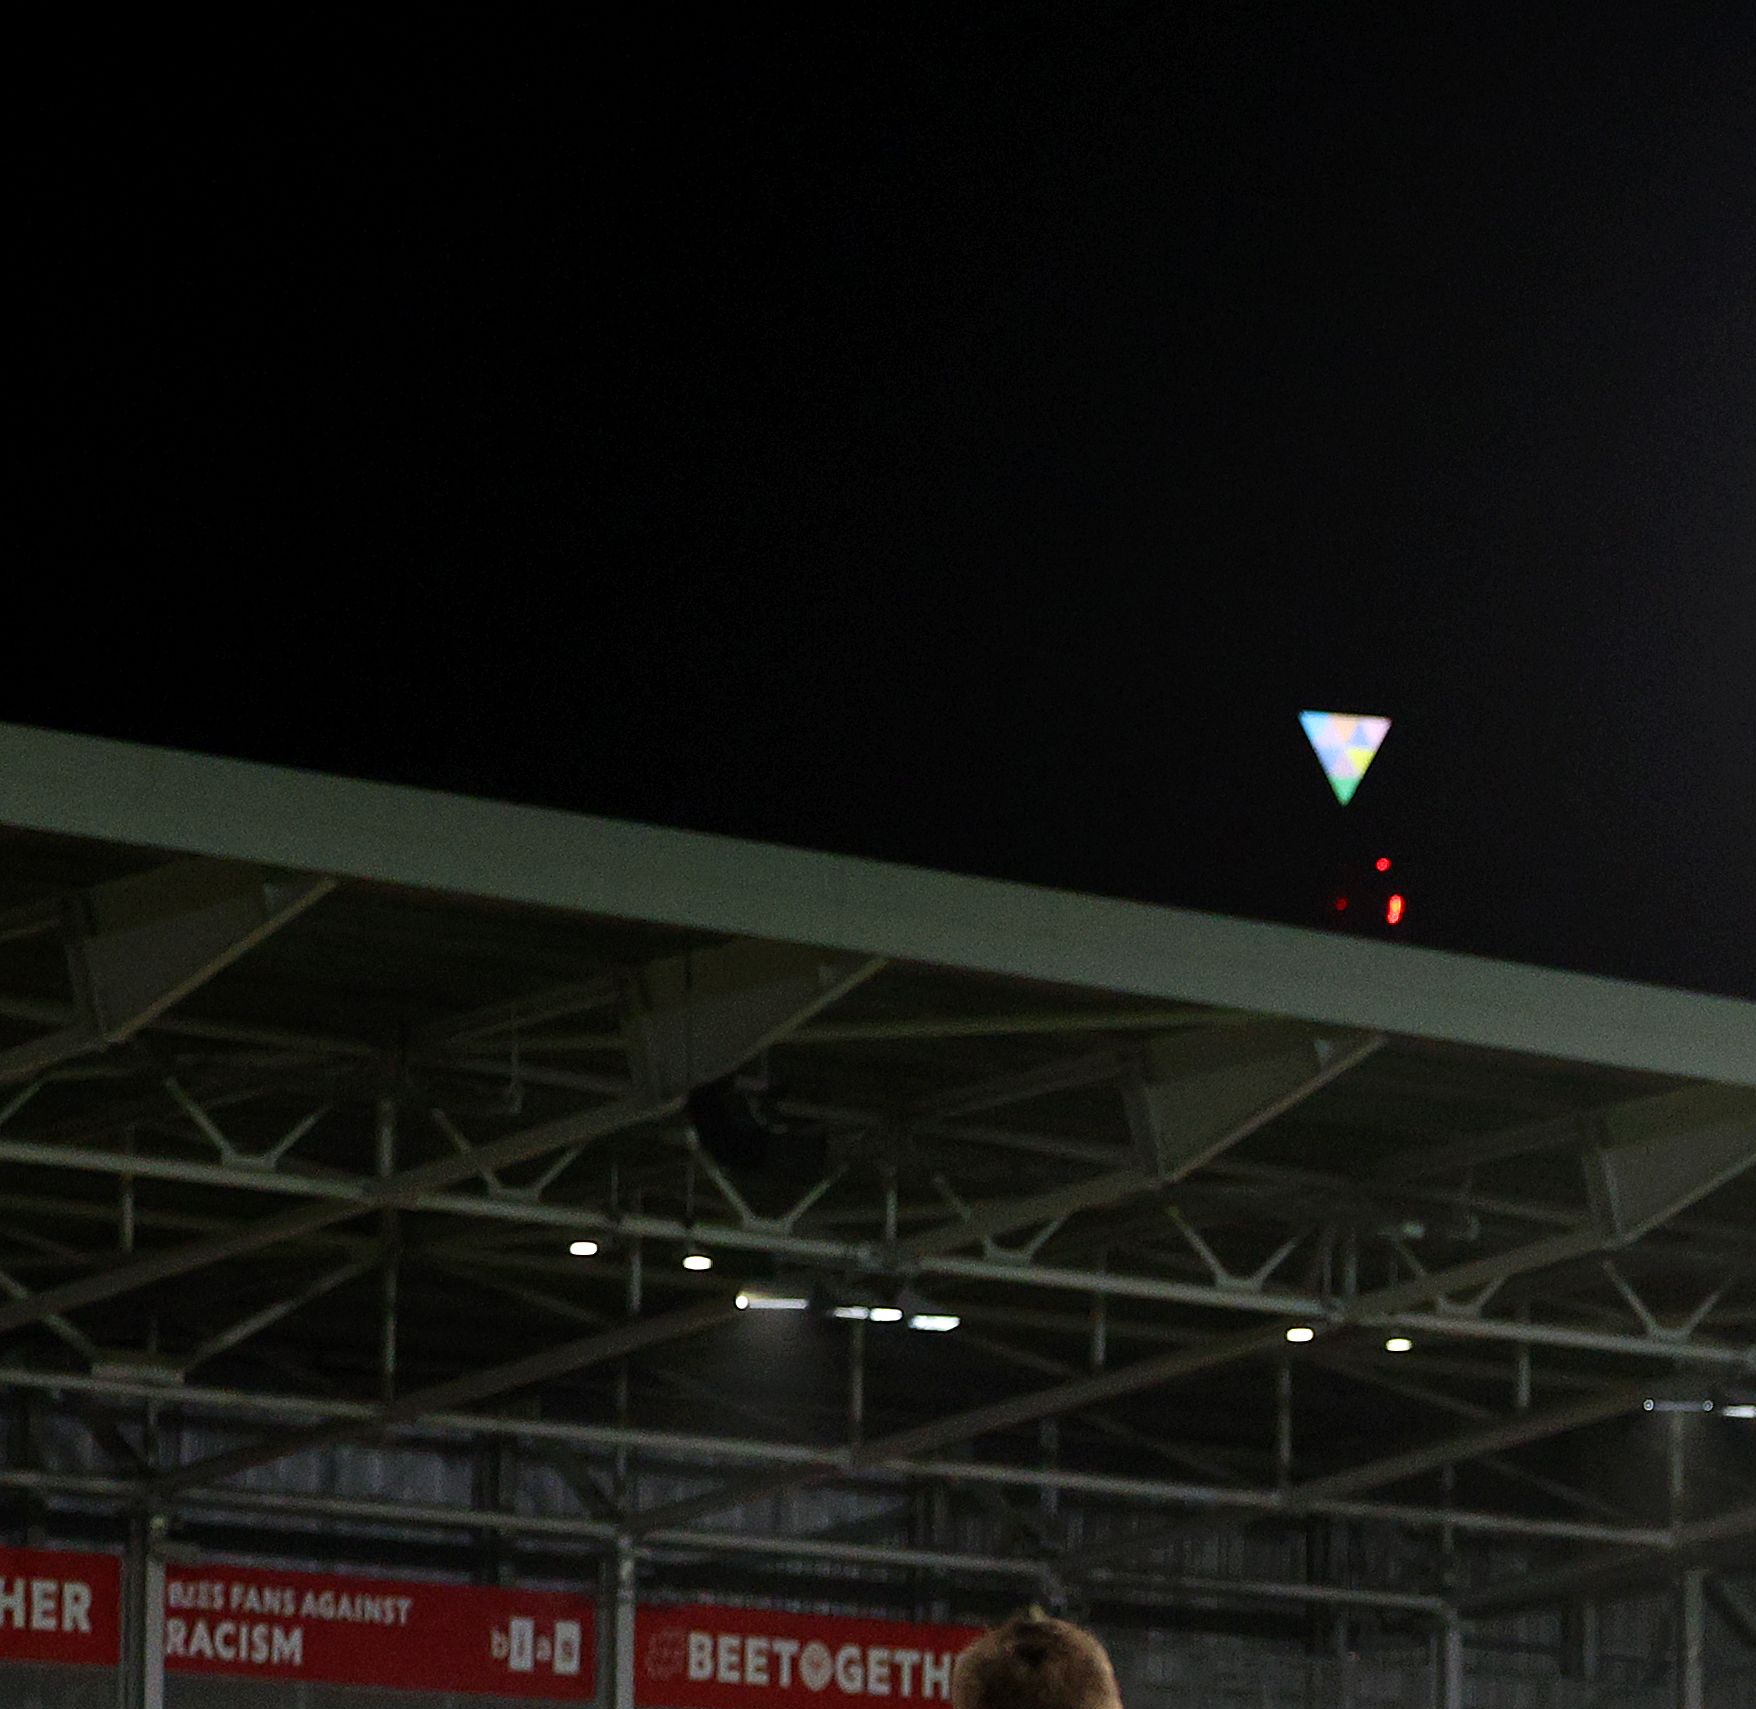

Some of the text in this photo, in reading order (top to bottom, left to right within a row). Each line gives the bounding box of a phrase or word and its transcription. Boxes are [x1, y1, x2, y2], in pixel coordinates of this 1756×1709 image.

[229, 1583, 296, 1616] FANS
[301, 1591, 412, 1626] AGAINST
[166, 1617, 304, 1666] RACISM
